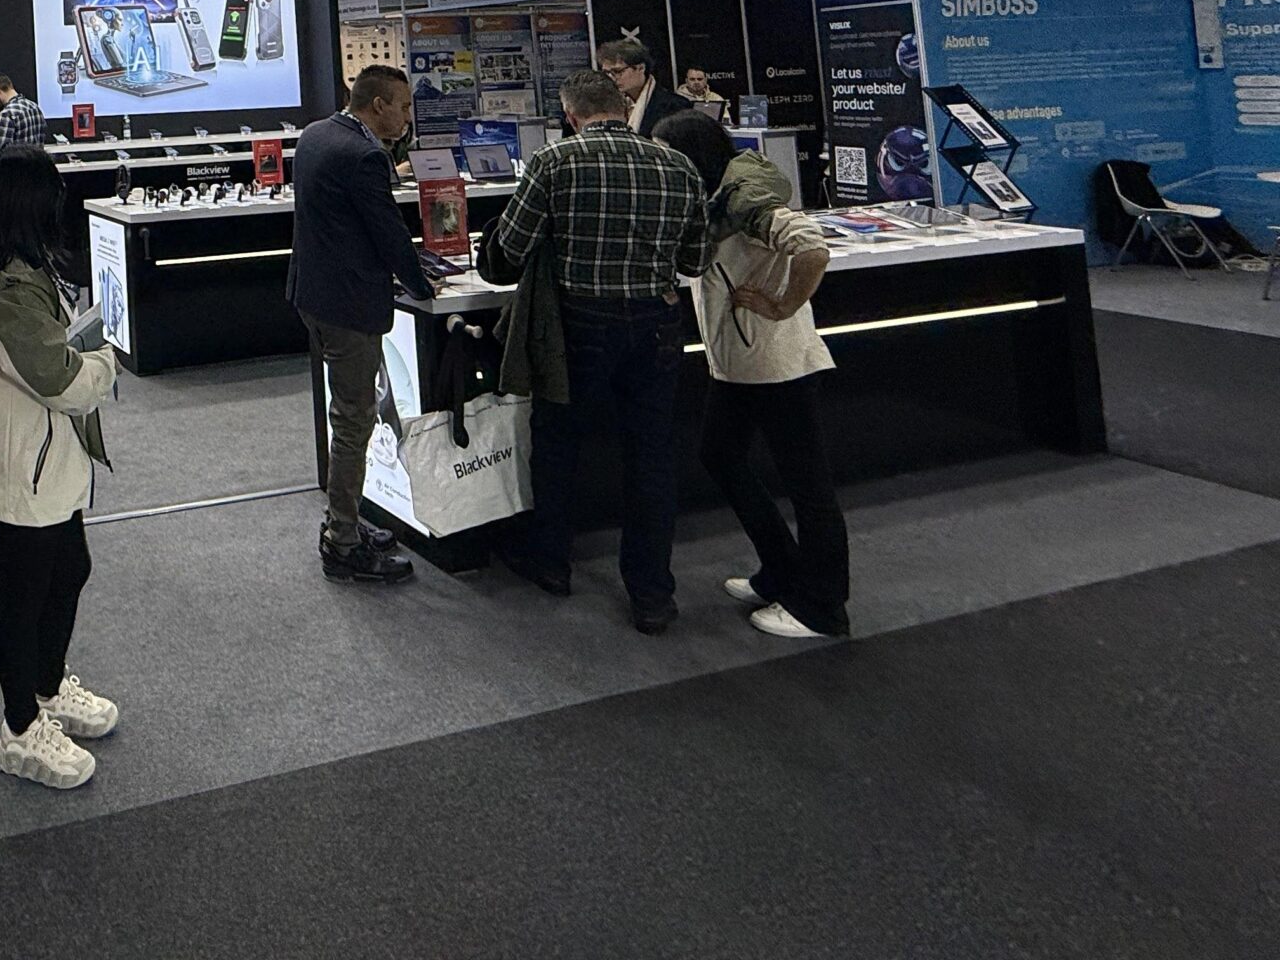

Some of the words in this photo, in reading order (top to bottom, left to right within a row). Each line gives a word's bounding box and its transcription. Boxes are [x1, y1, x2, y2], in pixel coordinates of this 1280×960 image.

[944, 35, 974, 48] About
[977, 36, 990, 46] us
[133, 46, 161, 71] AI
[831, 68, 847, 79] Let
[849, 70, 862, 79] us
[831, 84, 856, 97] your
[857, 82, 906, 95] website/
[833, 98, 875, 112] product
[1007, 106, 1063, 120] advantages
[187, 166, 230, 177] Blackview
[453, 446, 513, 480] Blackview
